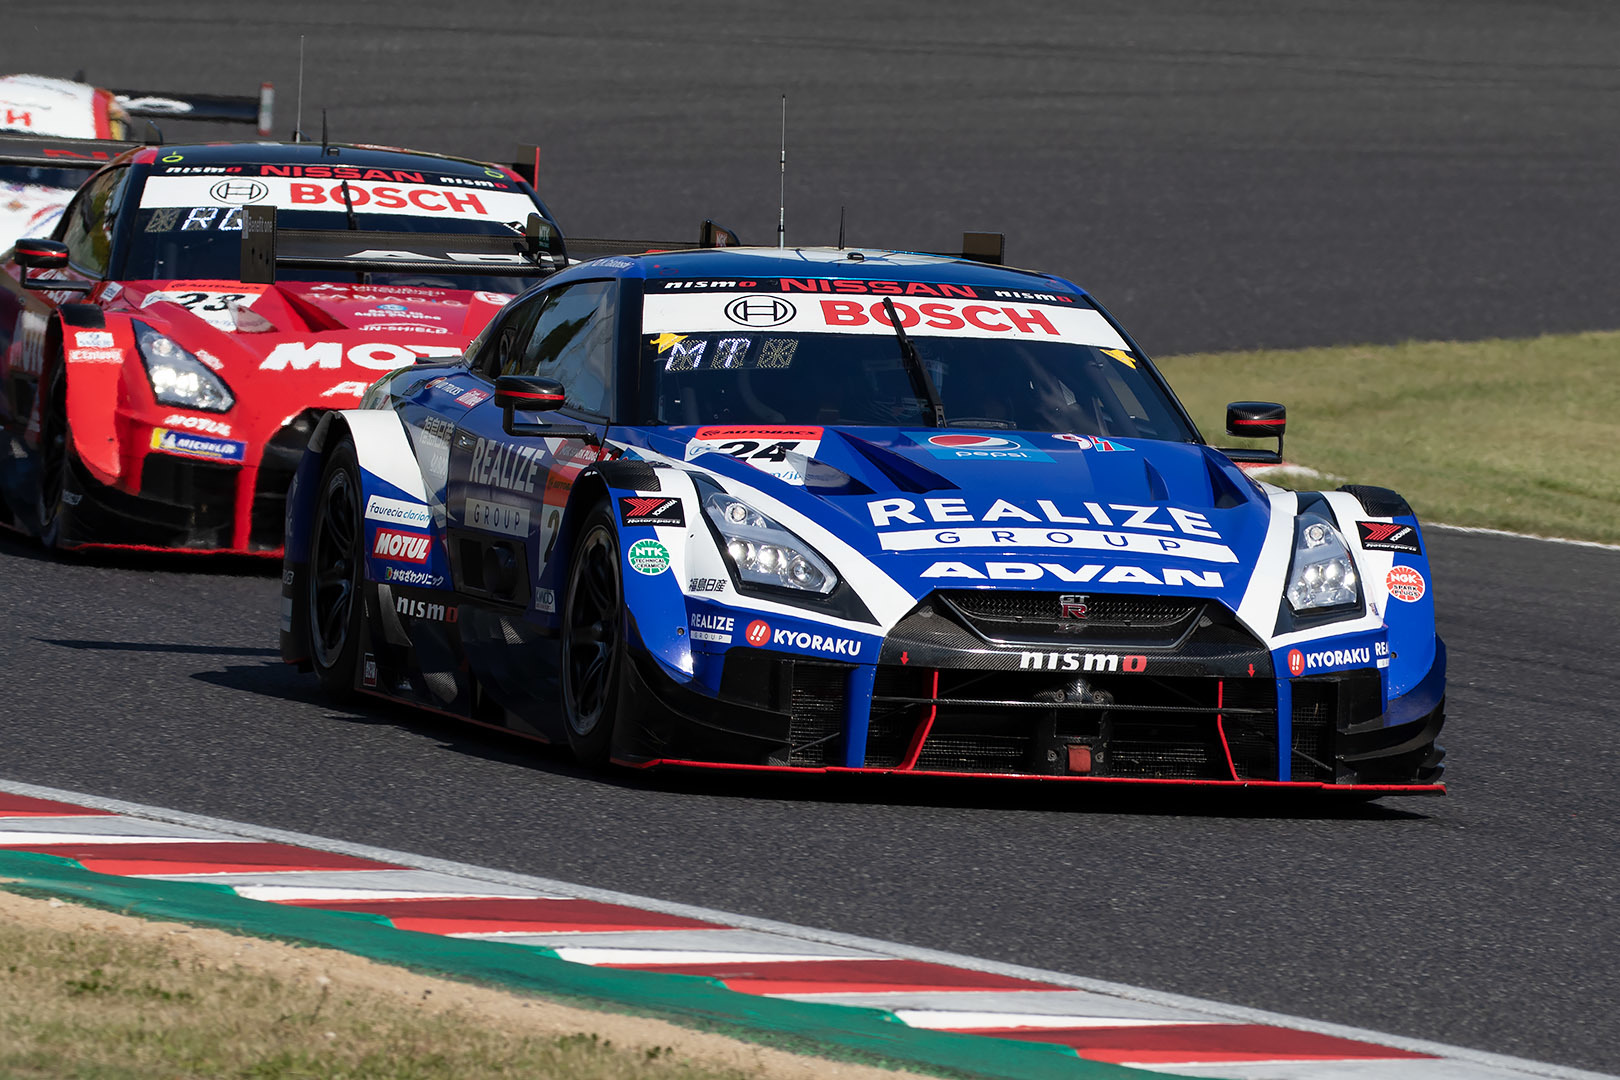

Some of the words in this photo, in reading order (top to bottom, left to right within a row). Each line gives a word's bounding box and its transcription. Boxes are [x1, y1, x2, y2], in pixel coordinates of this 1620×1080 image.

[260, 165, 425, 184] NISSAN
[290, 183, 489, 215] BOSCH
[664, 280, 757, 289] nismo
[780, 278, 979, 298] NISSAN
[994, 290, 1074, 303] nismo
[819, 299, 1061, 336] BOSCH
[718, 441, 801, 463] 24
[955, 450, 1030, 459] pepsi
[469, 437, 546, 493] REALIZE
[370, 502, 403, 518] faurecia
[402, 509, 431, 522] clarion
[473, 503, 521, 531] GROUP
[867, 498, 1222, 539] REALIZE
[374, 532, 431, 560] MOTUL
[635, 547, 664, 557] NTK
[934, 531, 1181, 552] GROUP
[688, 578, 728, 593] 福島日産
[919, 561, 1225, 588] ADVAN
[1390, 573, 1417, 584] NGK
[397, 596, 458, 623] nismo
[690, 612, 735, 632] REALIZE
[773, 628, 862, 656] KYORAKU
[1019, 651, 1147, 672] nismo
[1306, 647, 1370, 669] KYORAKU
